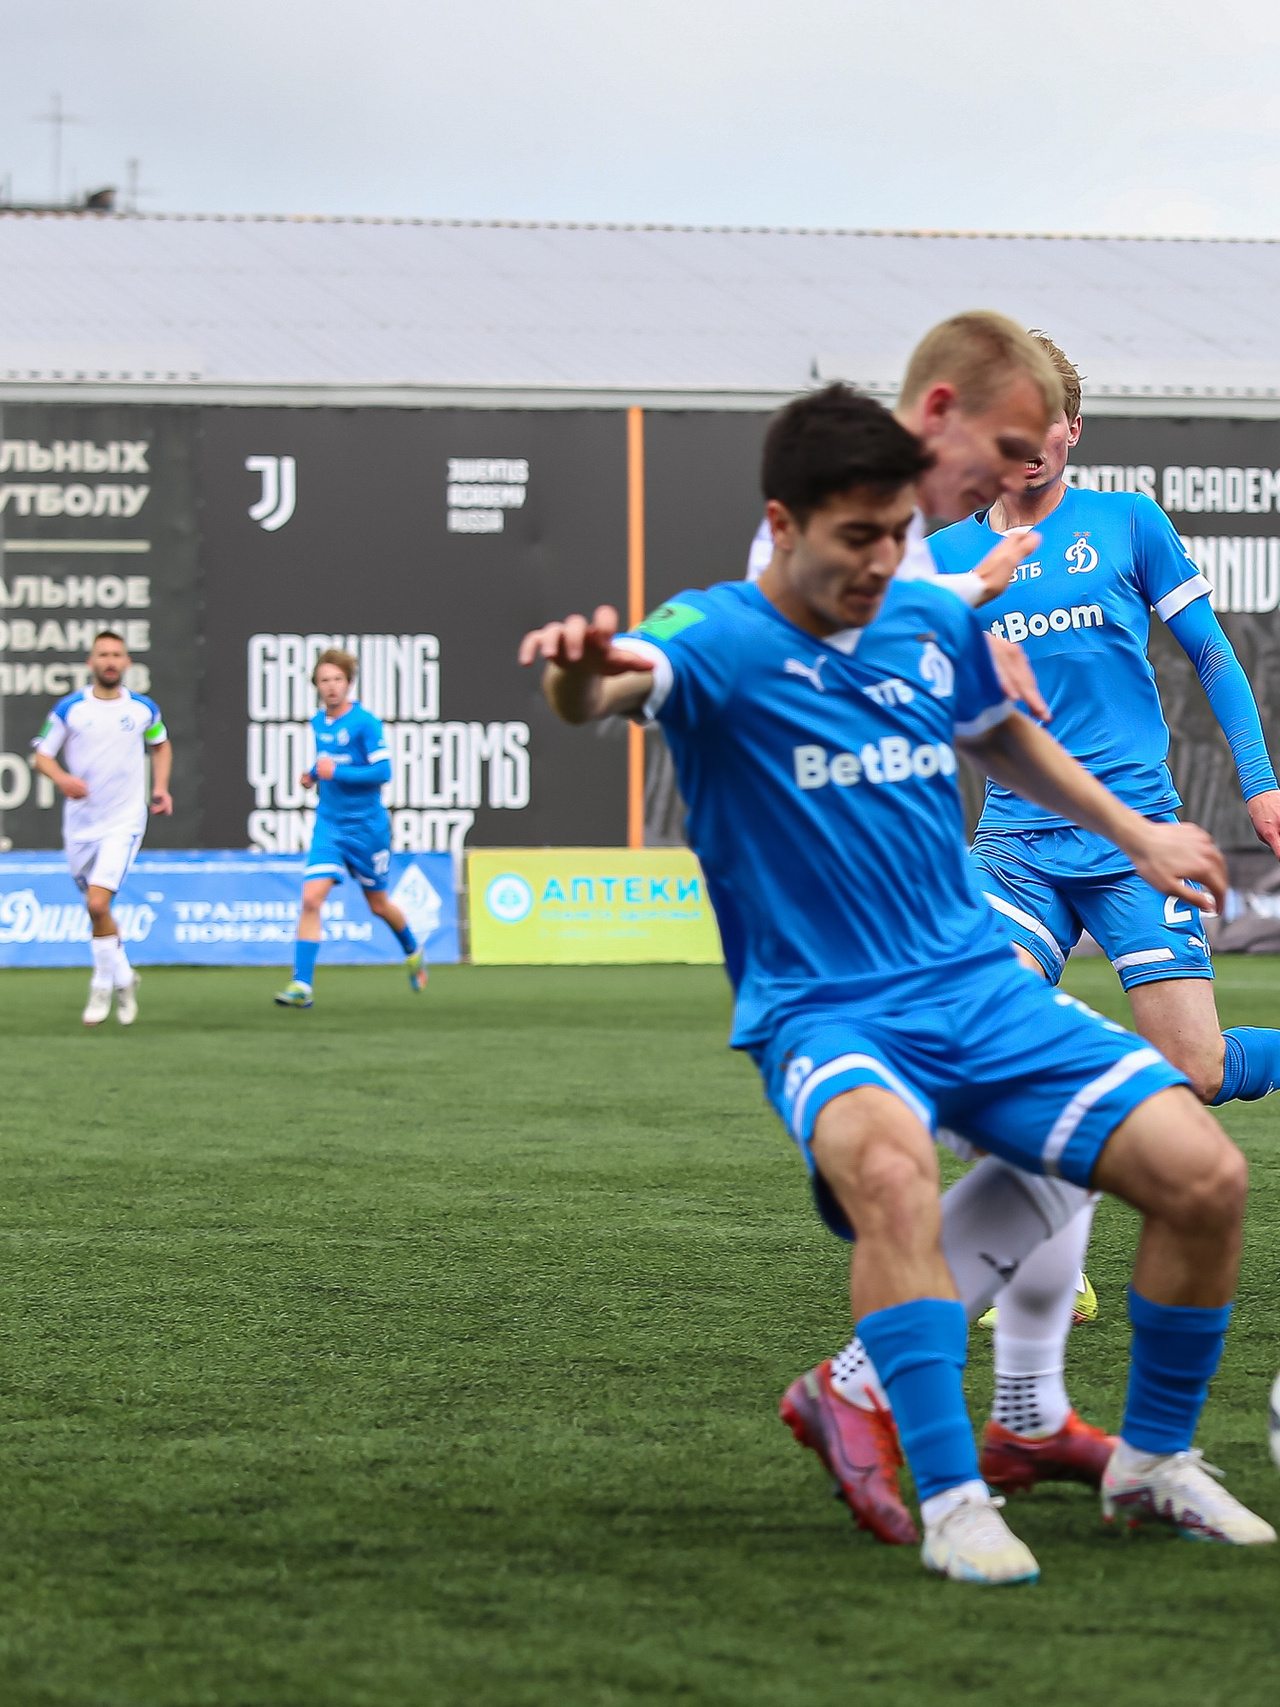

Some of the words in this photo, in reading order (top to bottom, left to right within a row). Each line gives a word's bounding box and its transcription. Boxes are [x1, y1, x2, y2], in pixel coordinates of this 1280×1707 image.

[0, 618, 150, 652] ВАНЕ
[990, 604, 1104, 644] tBoom
[0, 662, 151, 695] ИСТВ
[248, 633, 440, 721] GRING
[541, 877, 701, 904] АПТЕКИ
